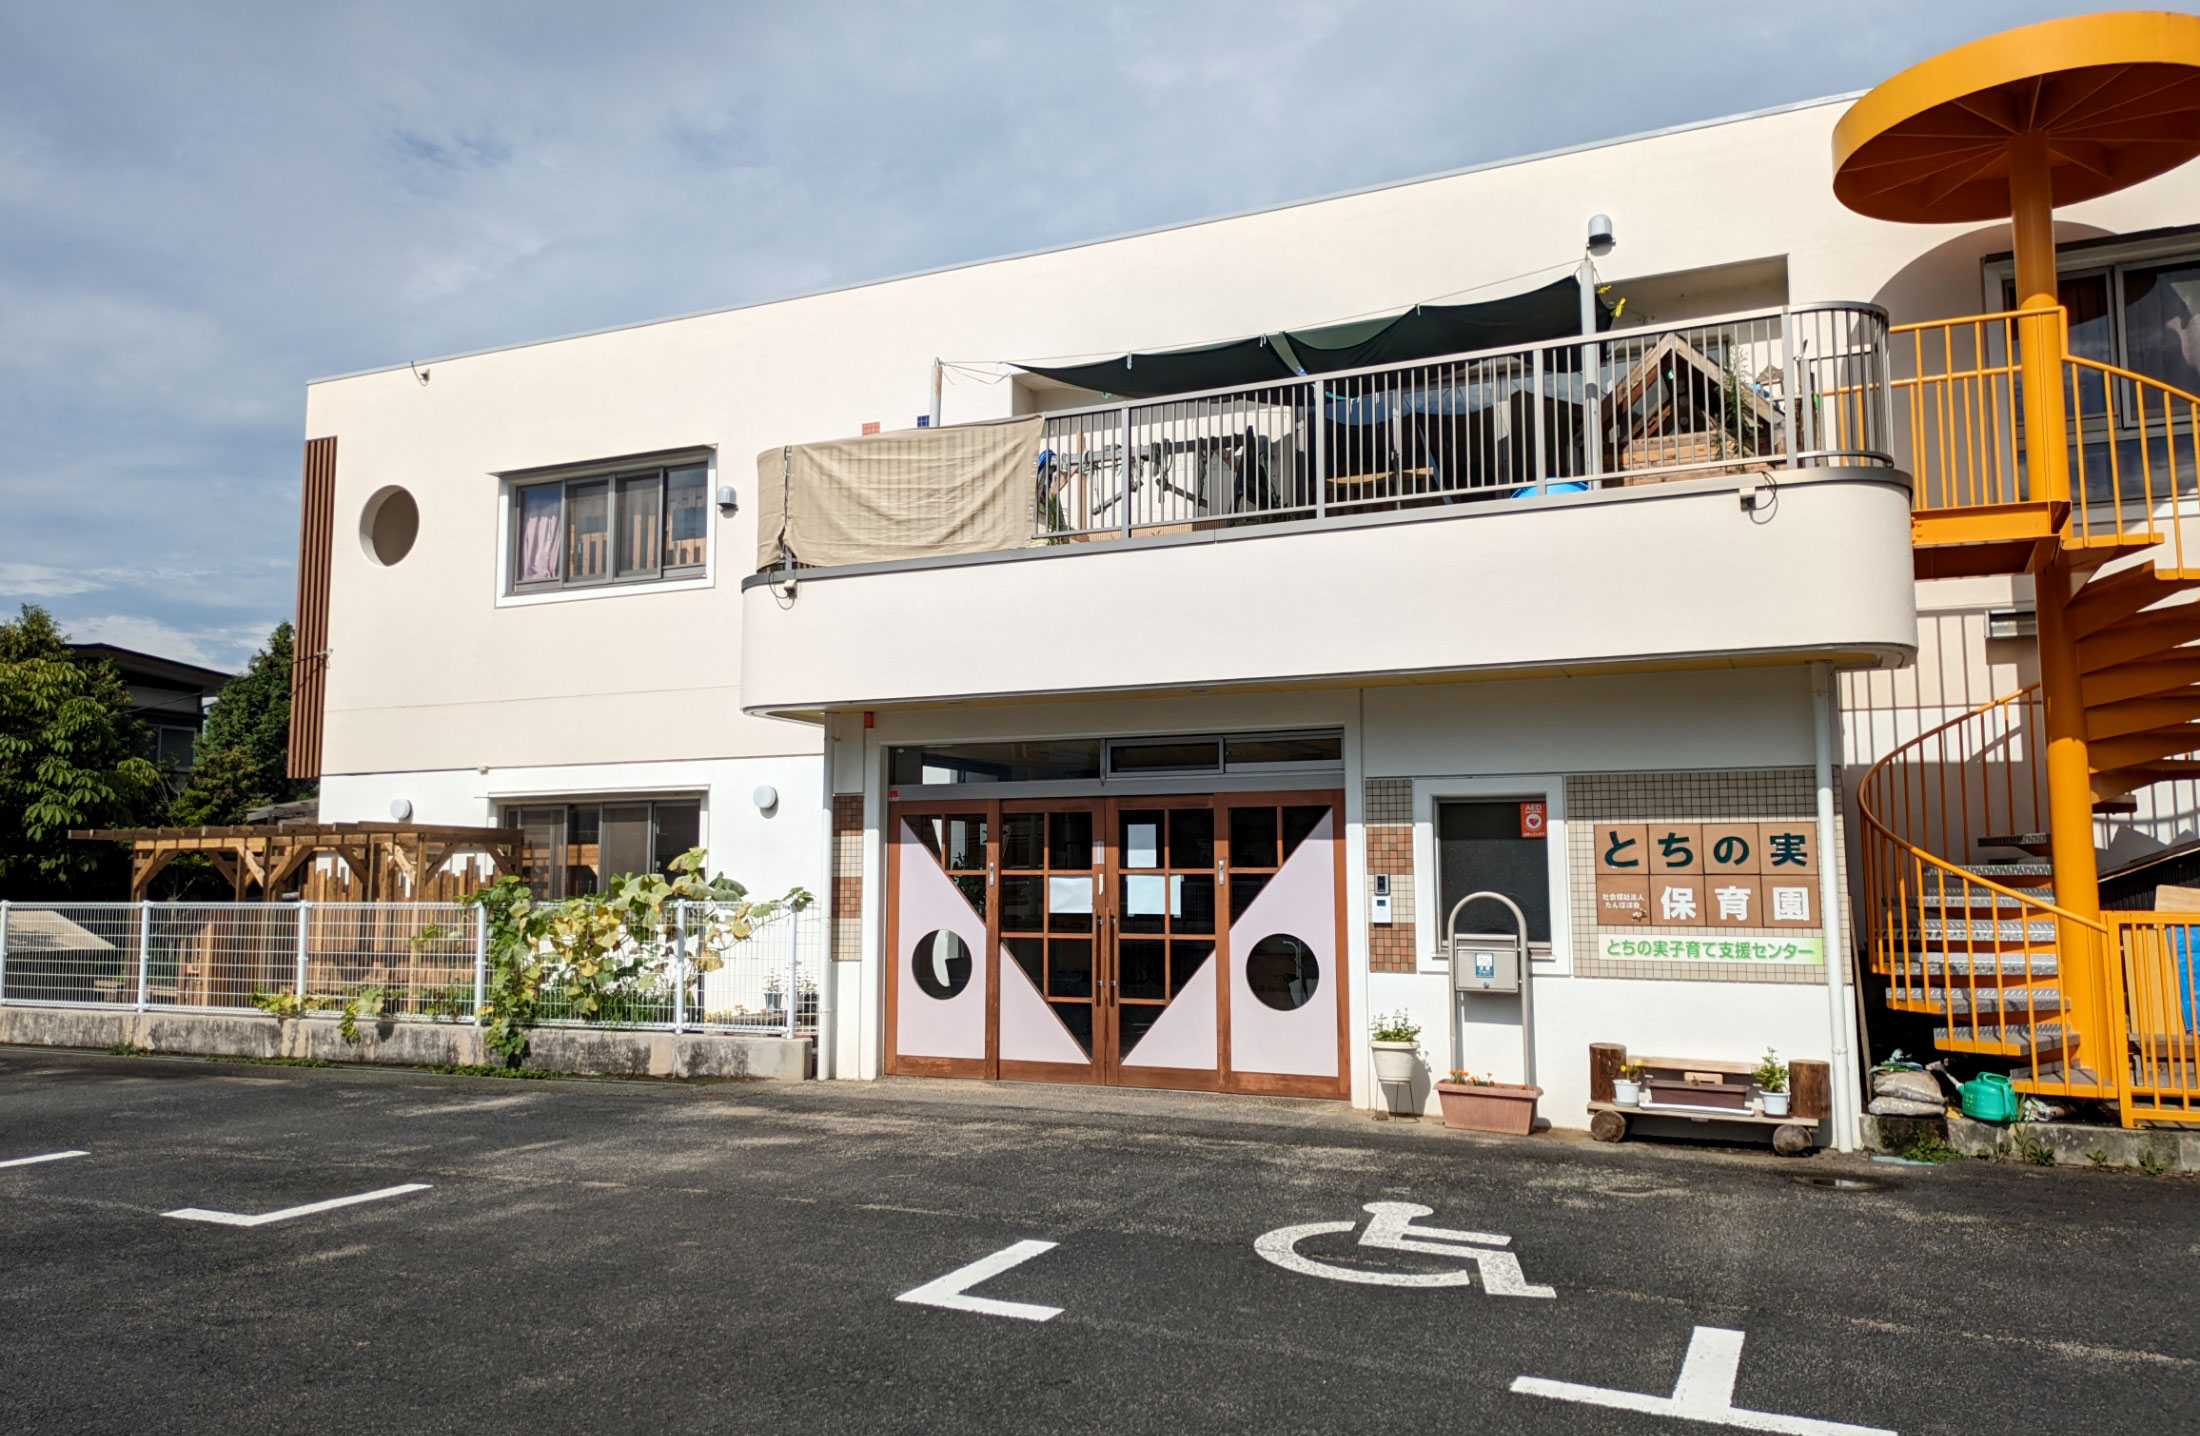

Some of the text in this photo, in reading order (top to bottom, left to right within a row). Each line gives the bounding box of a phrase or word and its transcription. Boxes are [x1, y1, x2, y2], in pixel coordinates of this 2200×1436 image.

[1525, 803, 1542, 811] AED
[1604, 831, 1808, 867] とちの実
[1660, 886, 1810, 921] 保育園
[1607, 939, 1814, 959] とちの実子育て支援センター
